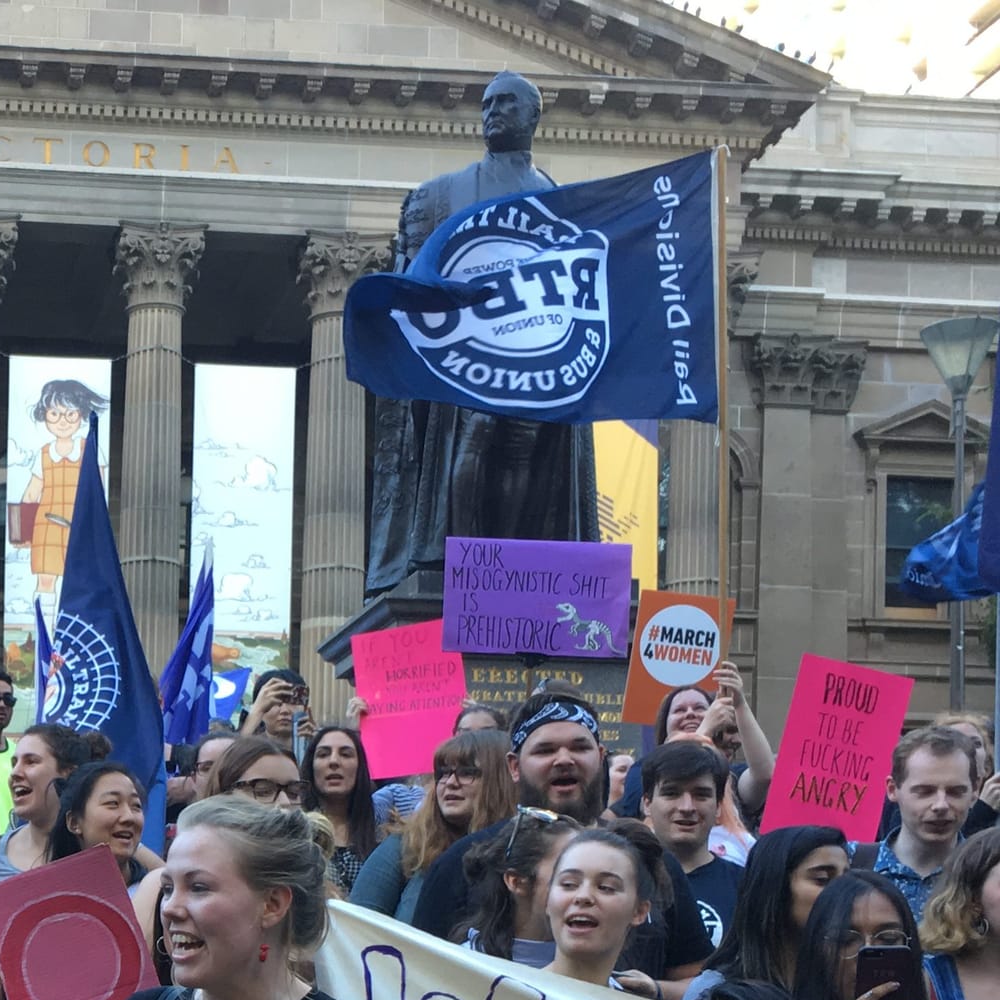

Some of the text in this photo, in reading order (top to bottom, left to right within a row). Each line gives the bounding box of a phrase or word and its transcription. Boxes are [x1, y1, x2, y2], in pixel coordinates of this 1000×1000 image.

[460, 543, 505, 568] YOUR
[452, 566, 612, 600] MISOGYNISTIC SHIT
[463, 592, 479, 613] IS
[389, 628, 427, 652] YOU
[457, 613, 562, 652] PREHISTORIC
[648, 624, 716, 649] #MARCH
[643, 642, 714, 667] 4WOMEN
[385, 660, 457, 683] HORRIFIED
[822, 672, 880, 715] PROUD
[818, 711, 865, 747] TO BE
[800, 738, 874, 782] FUCKING
[790, 771, 868, 816] ANGRY
